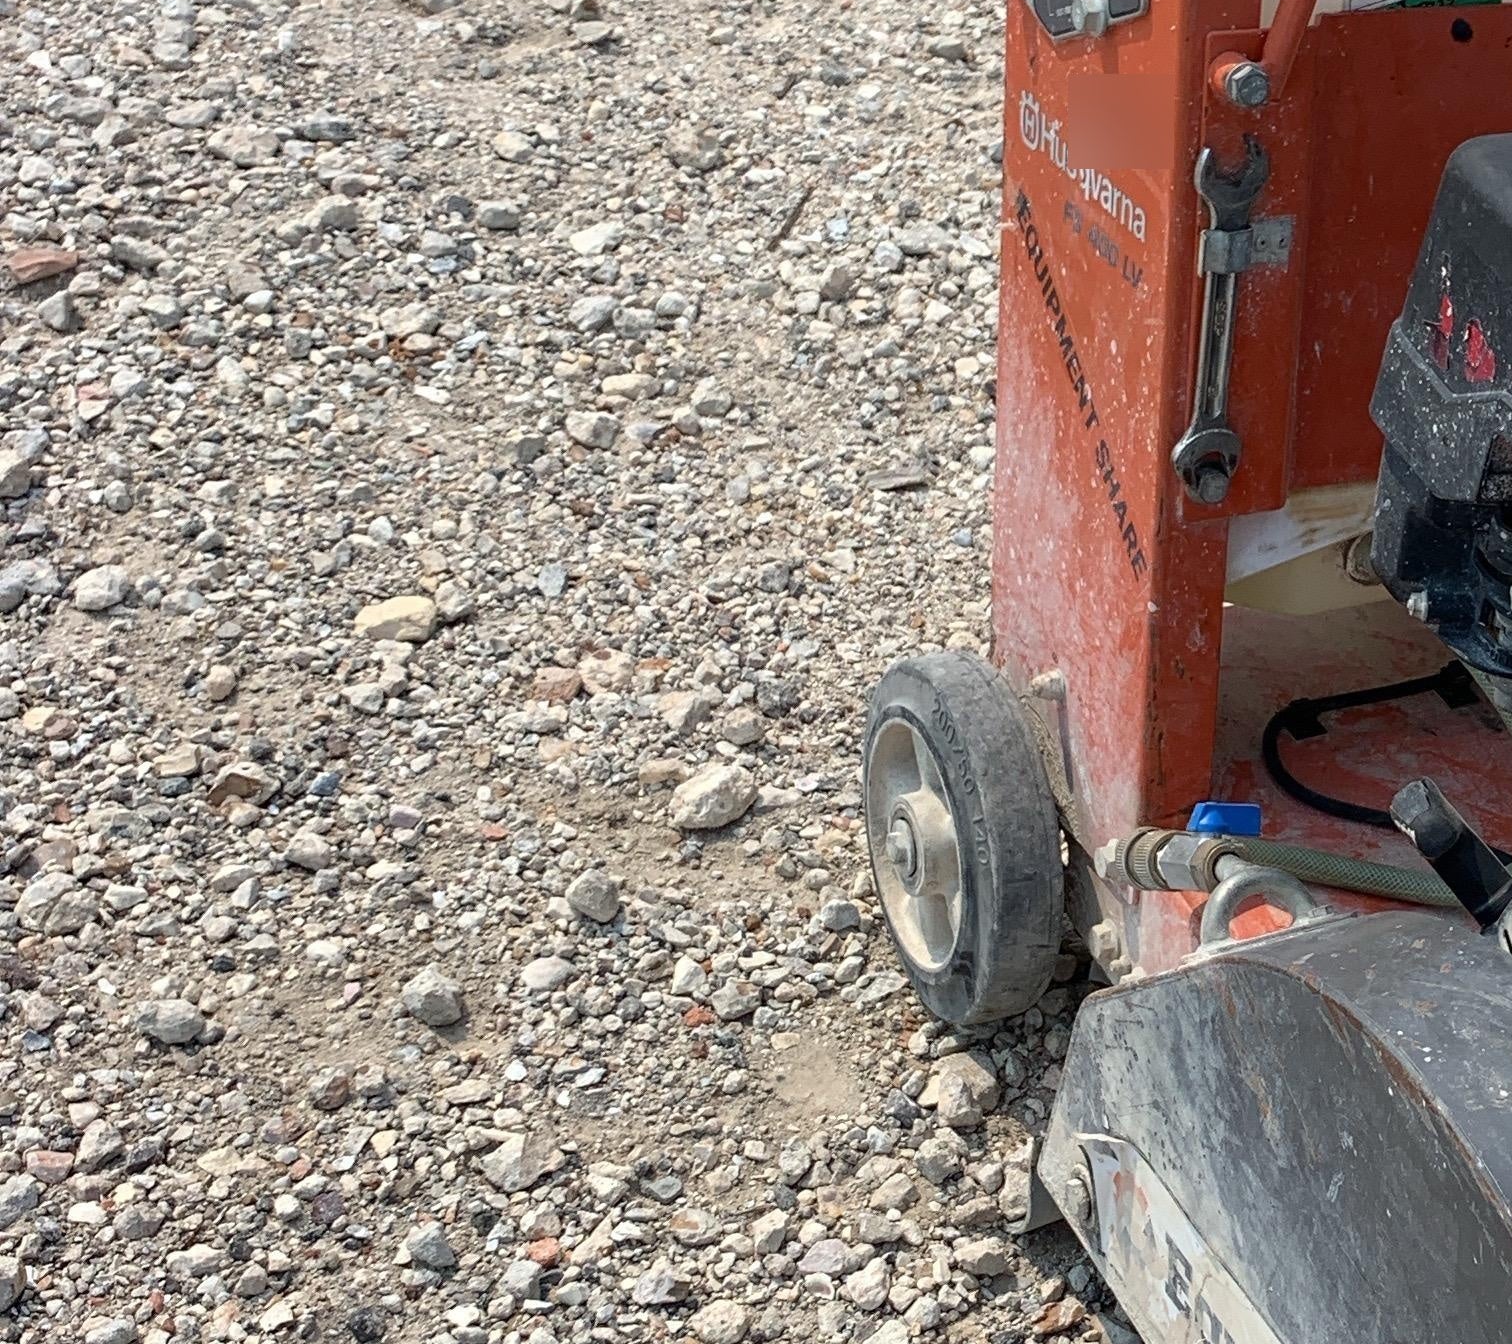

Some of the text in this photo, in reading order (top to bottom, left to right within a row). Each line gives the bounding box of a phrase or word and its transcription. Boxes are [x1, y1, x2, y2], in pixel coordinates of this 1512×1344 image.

[1015, 201, 1146, 582] EQUIPMENT SHARE
[972, 816, 990, 865] 140
